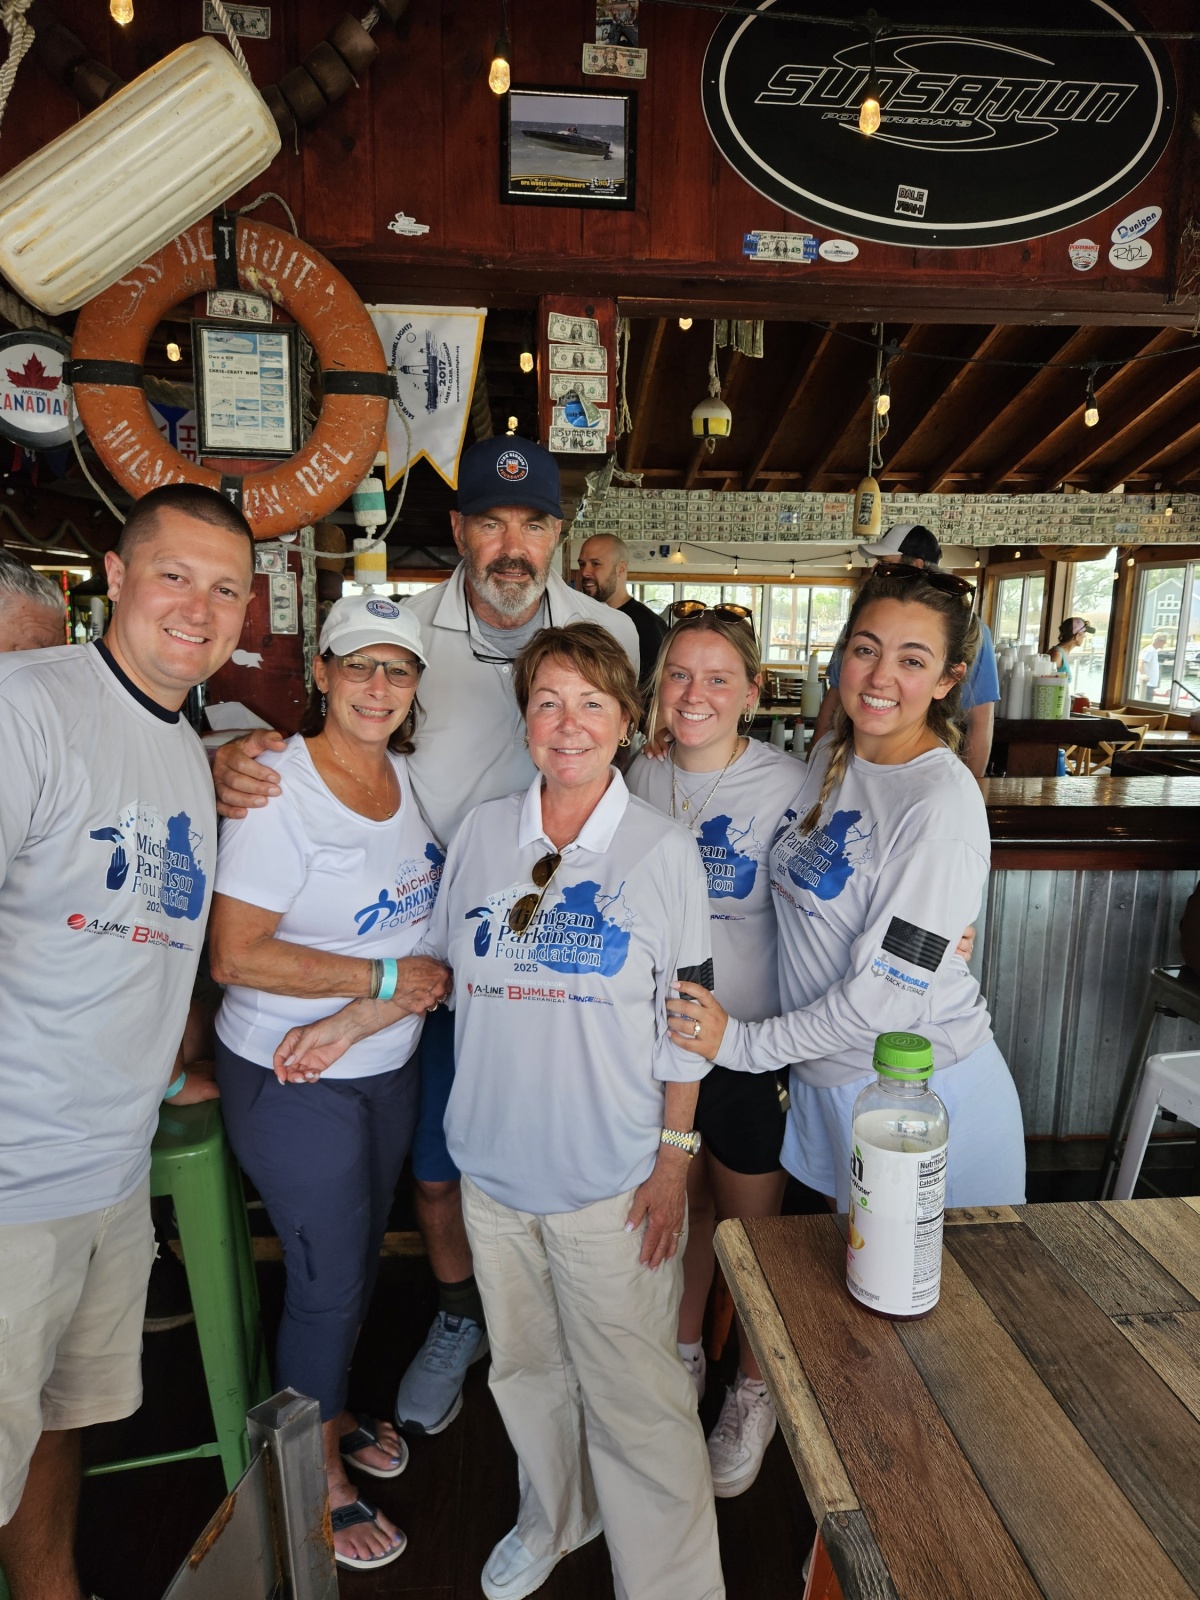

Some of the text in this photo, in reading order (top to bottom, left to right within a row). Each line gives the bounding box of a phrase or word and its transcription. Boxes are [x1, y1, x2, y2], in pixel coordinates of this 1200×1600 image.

[754, 64, 1138, 122] SUNSATION
[898, 187, 925, 202] DALE
[1117, 212, 1157, 236] Dunigan
[395, 322, 413, 341] LIGHTS
[390, 341, 399, 366] HANNEL
[438, 359, 447, 387] 2017
[22, 389, 48, 397] MOLSON
[0, 392, 69, 417] ANADIA
[398, 406, 415, 420] SAVE
[396, 866, 444, 898] MICHIGA
[87, 919, 131, 935] A-LINE
[497, 925, 603, 949] Parkinson
[495, 943, 601, 966] Foundation
[514, 963, 538, 973] 2025
[474, 984, 504, 995] A-LINE
[884, 975, 901, 988] RACK
[507, 985, 566, 1000] BUMLER
[919, 1176, 940, 1187] Calories
